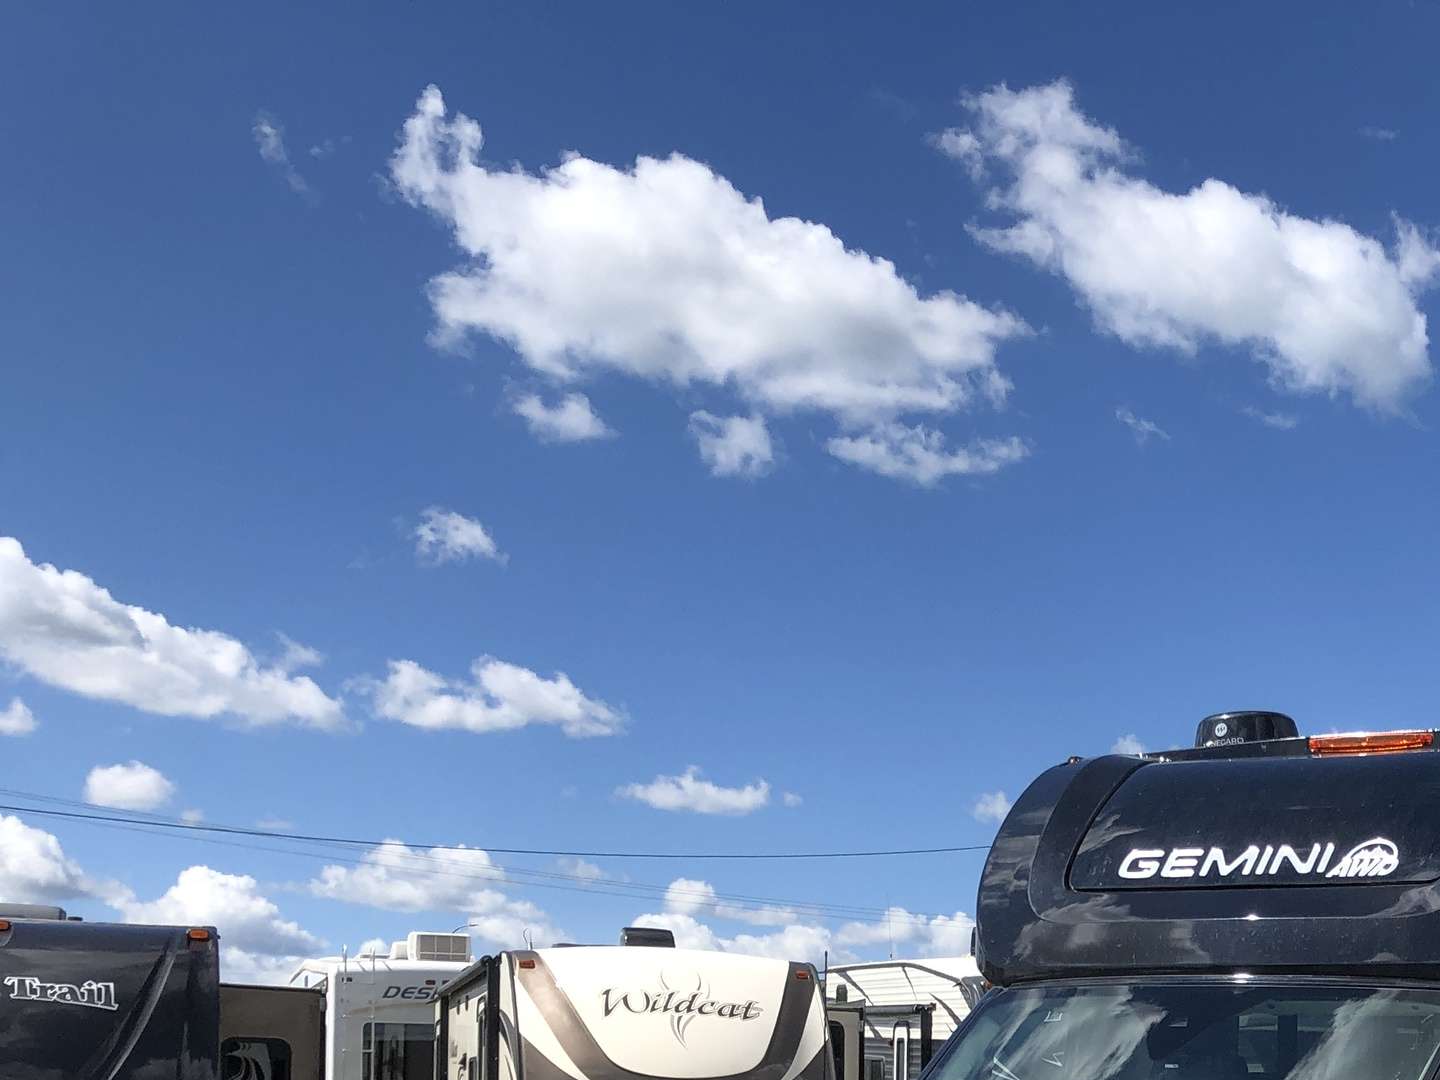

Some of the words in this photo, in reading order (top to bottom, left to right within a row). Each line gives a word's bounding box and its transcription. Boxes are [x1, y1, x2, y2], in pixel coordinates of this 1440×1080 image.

[1118, 842, 1335, 879] GEMINI
[1325, 852, 1399, 878] AWD
[3, 976, 119, 1011] Trail
[601, 987, 764, 1021] Wildcat
